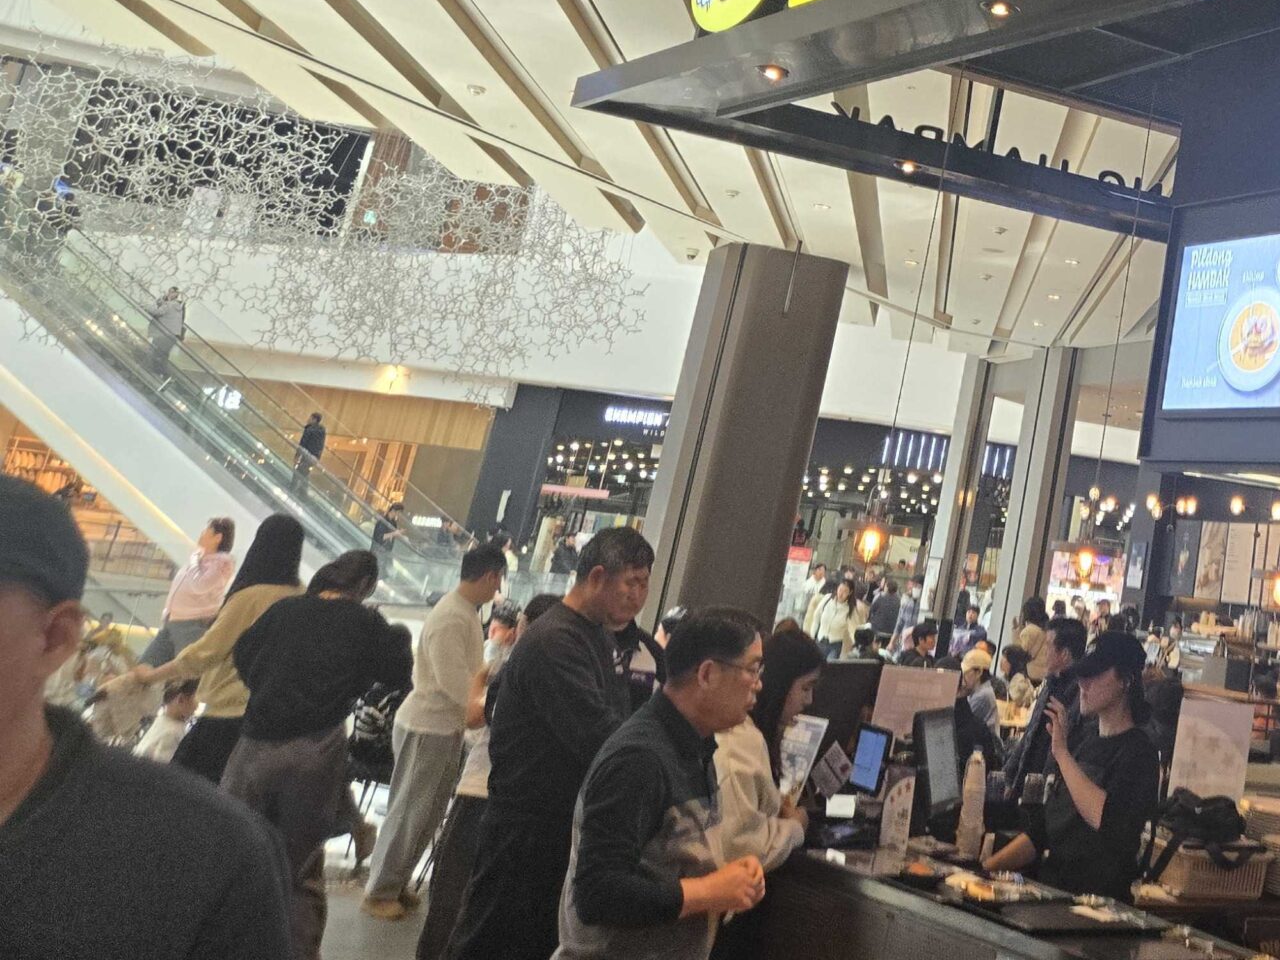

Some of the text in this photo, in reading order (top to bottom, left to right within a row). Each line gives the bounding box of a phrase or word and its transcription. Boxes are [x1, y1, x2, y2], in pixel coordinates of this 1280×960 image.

[1191, 246, 1233, 268] Pildong
[1188, 268, 1230, 290] HAMBAK
[605, 406, 662, 426] CHAMPION
